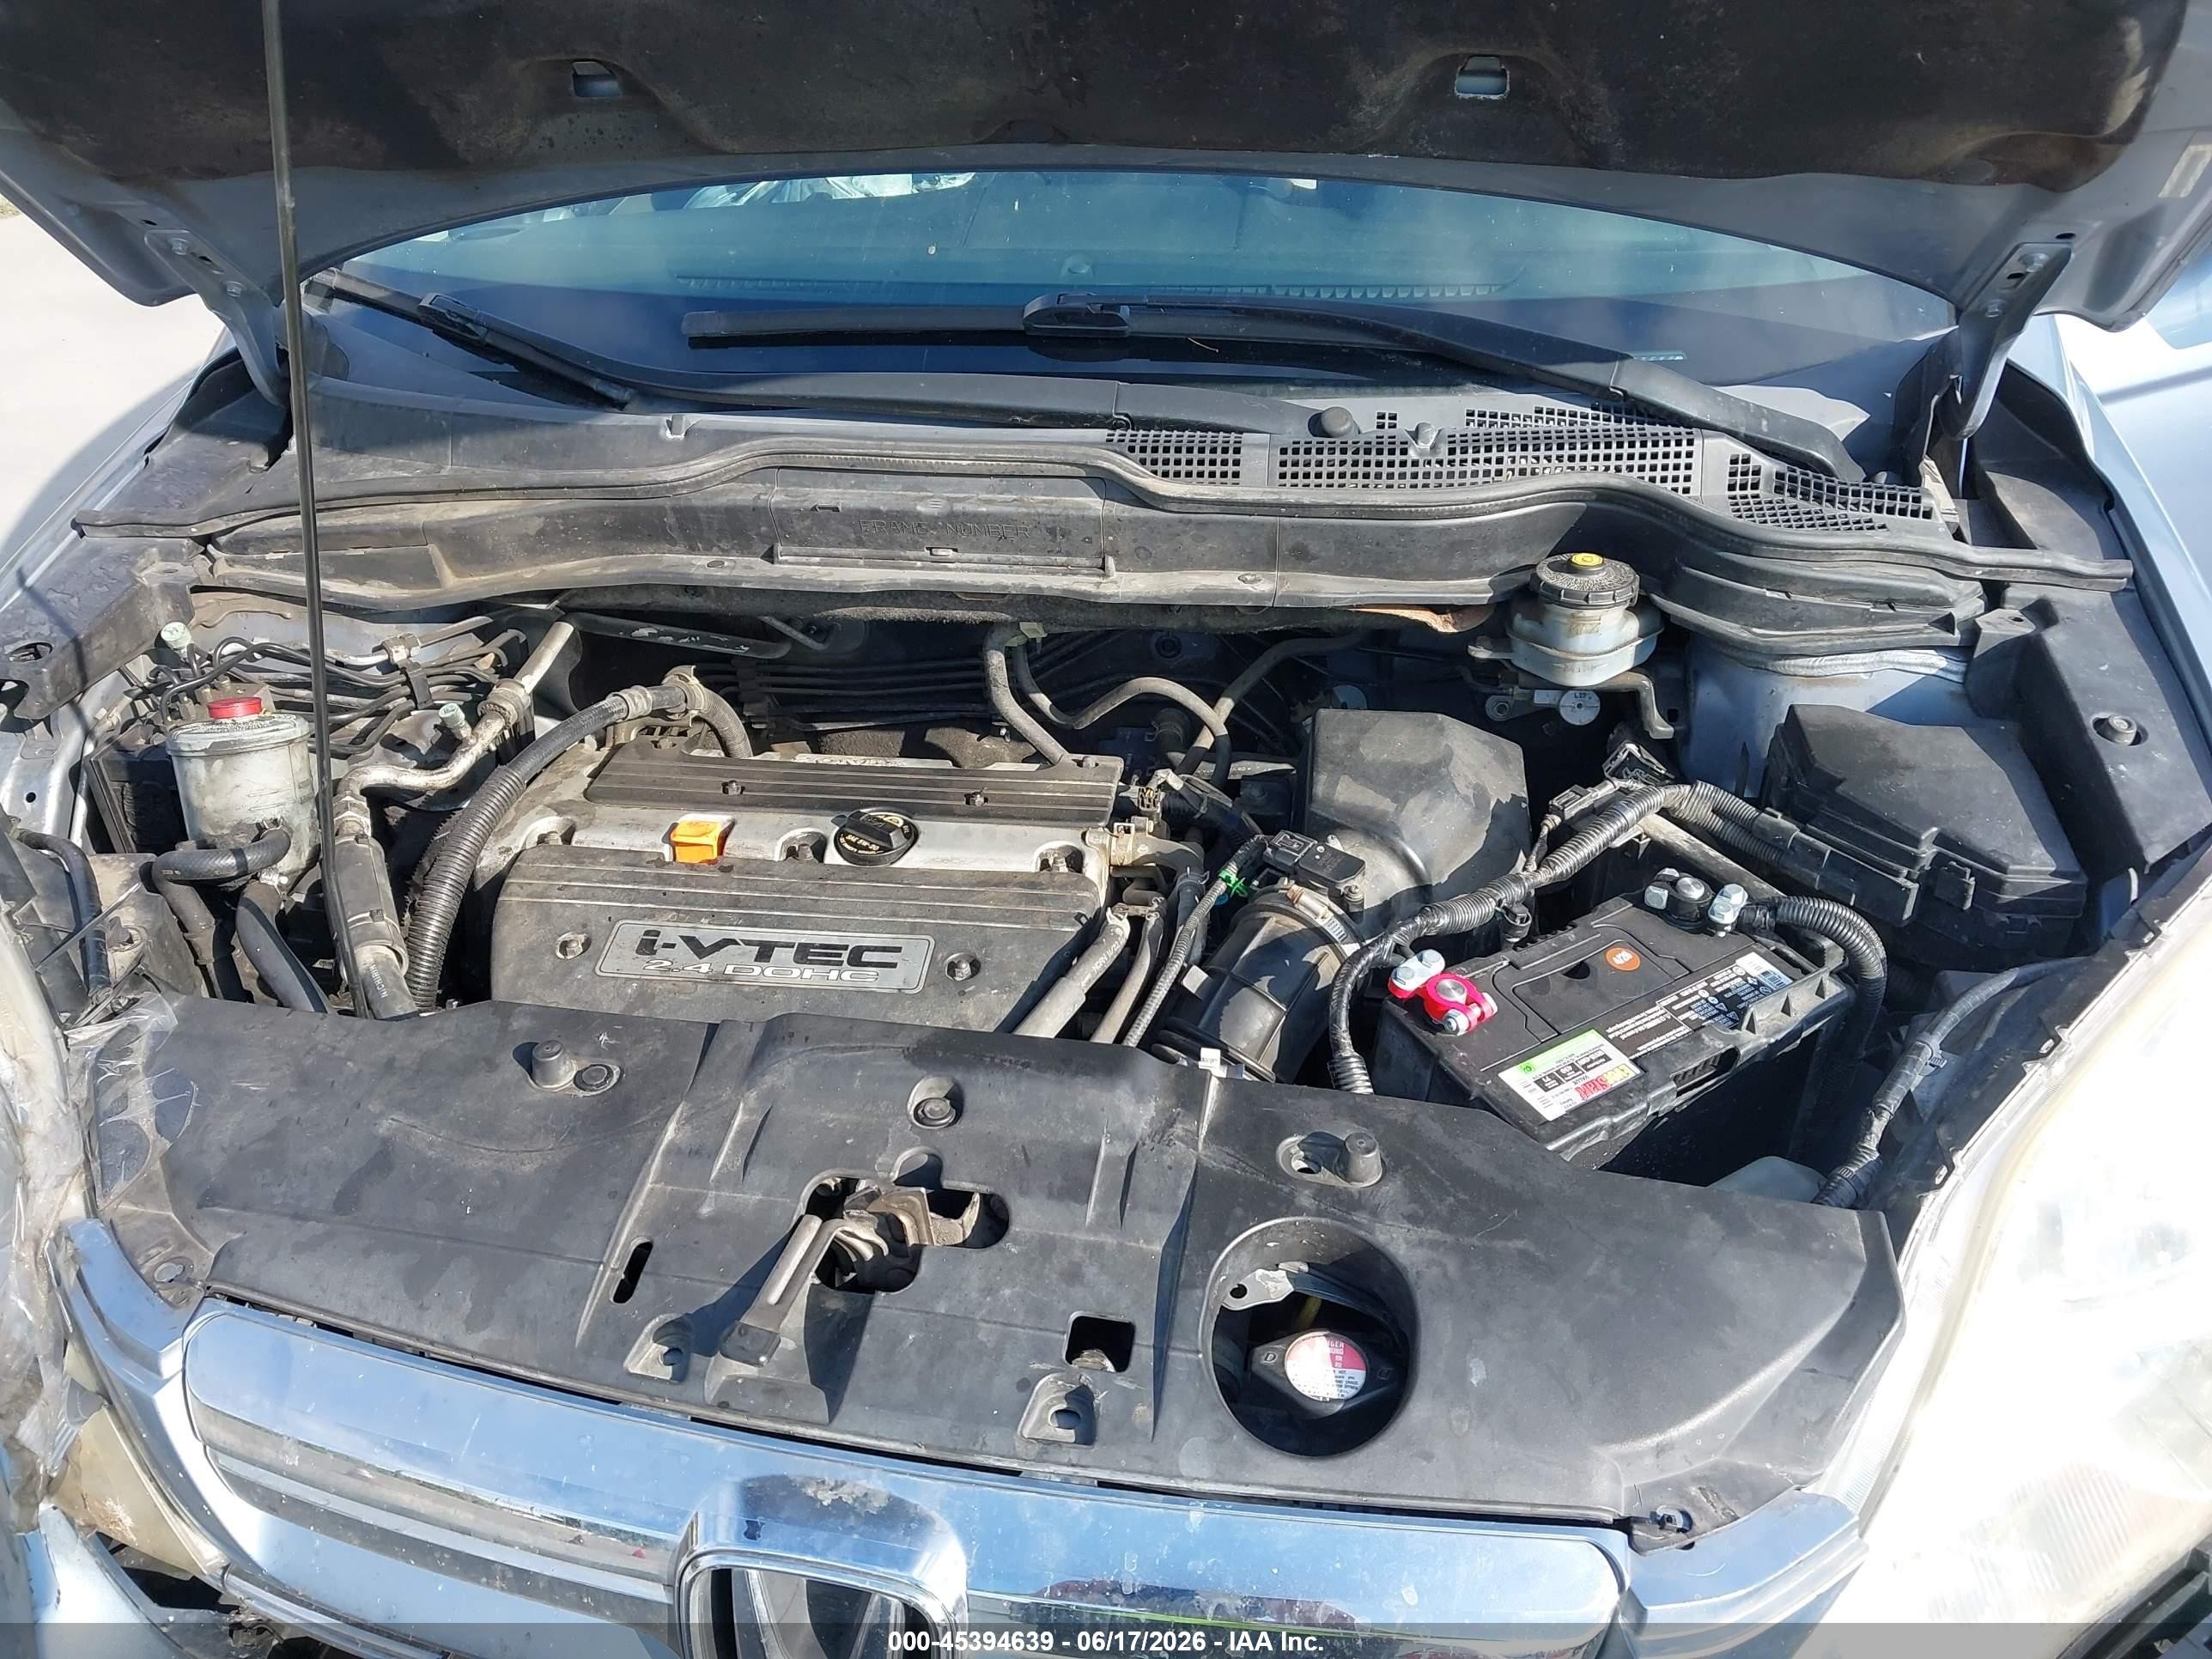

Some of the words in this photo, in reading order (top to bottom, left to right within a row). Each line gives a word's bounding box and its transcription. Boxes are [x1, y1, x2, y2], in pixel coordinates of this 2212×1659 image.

[945, 522, 1031, 539] NUMBER
[845, 834, 860, 843] SAE
[856, 838, 880, 851] 5W-20
[635, 929, 904, 969] i-VTEC
[642, 958, 714, 975] 2.4
[719, 963, 880, 984] DOHC
